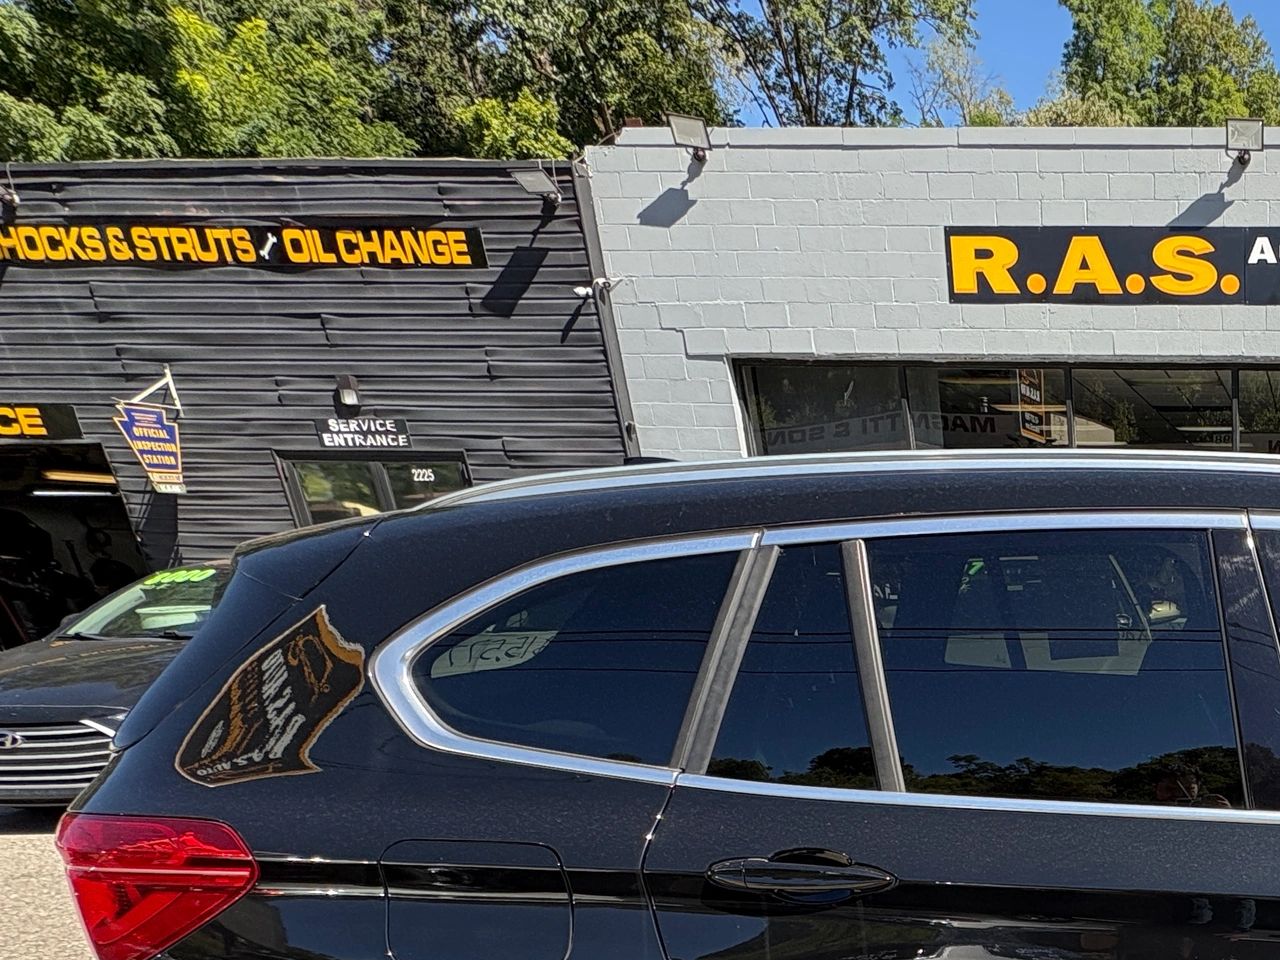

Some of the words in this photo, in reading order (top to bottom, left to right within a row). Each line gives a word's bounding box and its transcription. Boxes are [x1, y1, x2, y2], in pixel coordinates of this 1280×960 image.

[131, 226, 257, 263] STRUTS
[282, 228, 338, 264] OIL
[335, 230, 473, 265] CHANGE
[950, 235, 1240, 295] R.A.S.
[327, 418, 398, 432] SERVICE
[132, 426, 171, 439] OFFICIAL
[132, 440, 177, 452] INSPECTION
[322, 433, 409, 447] ENTRANCE
[142, 454, 177, 465] STATION
[411, 468, 436, 482] 2225
